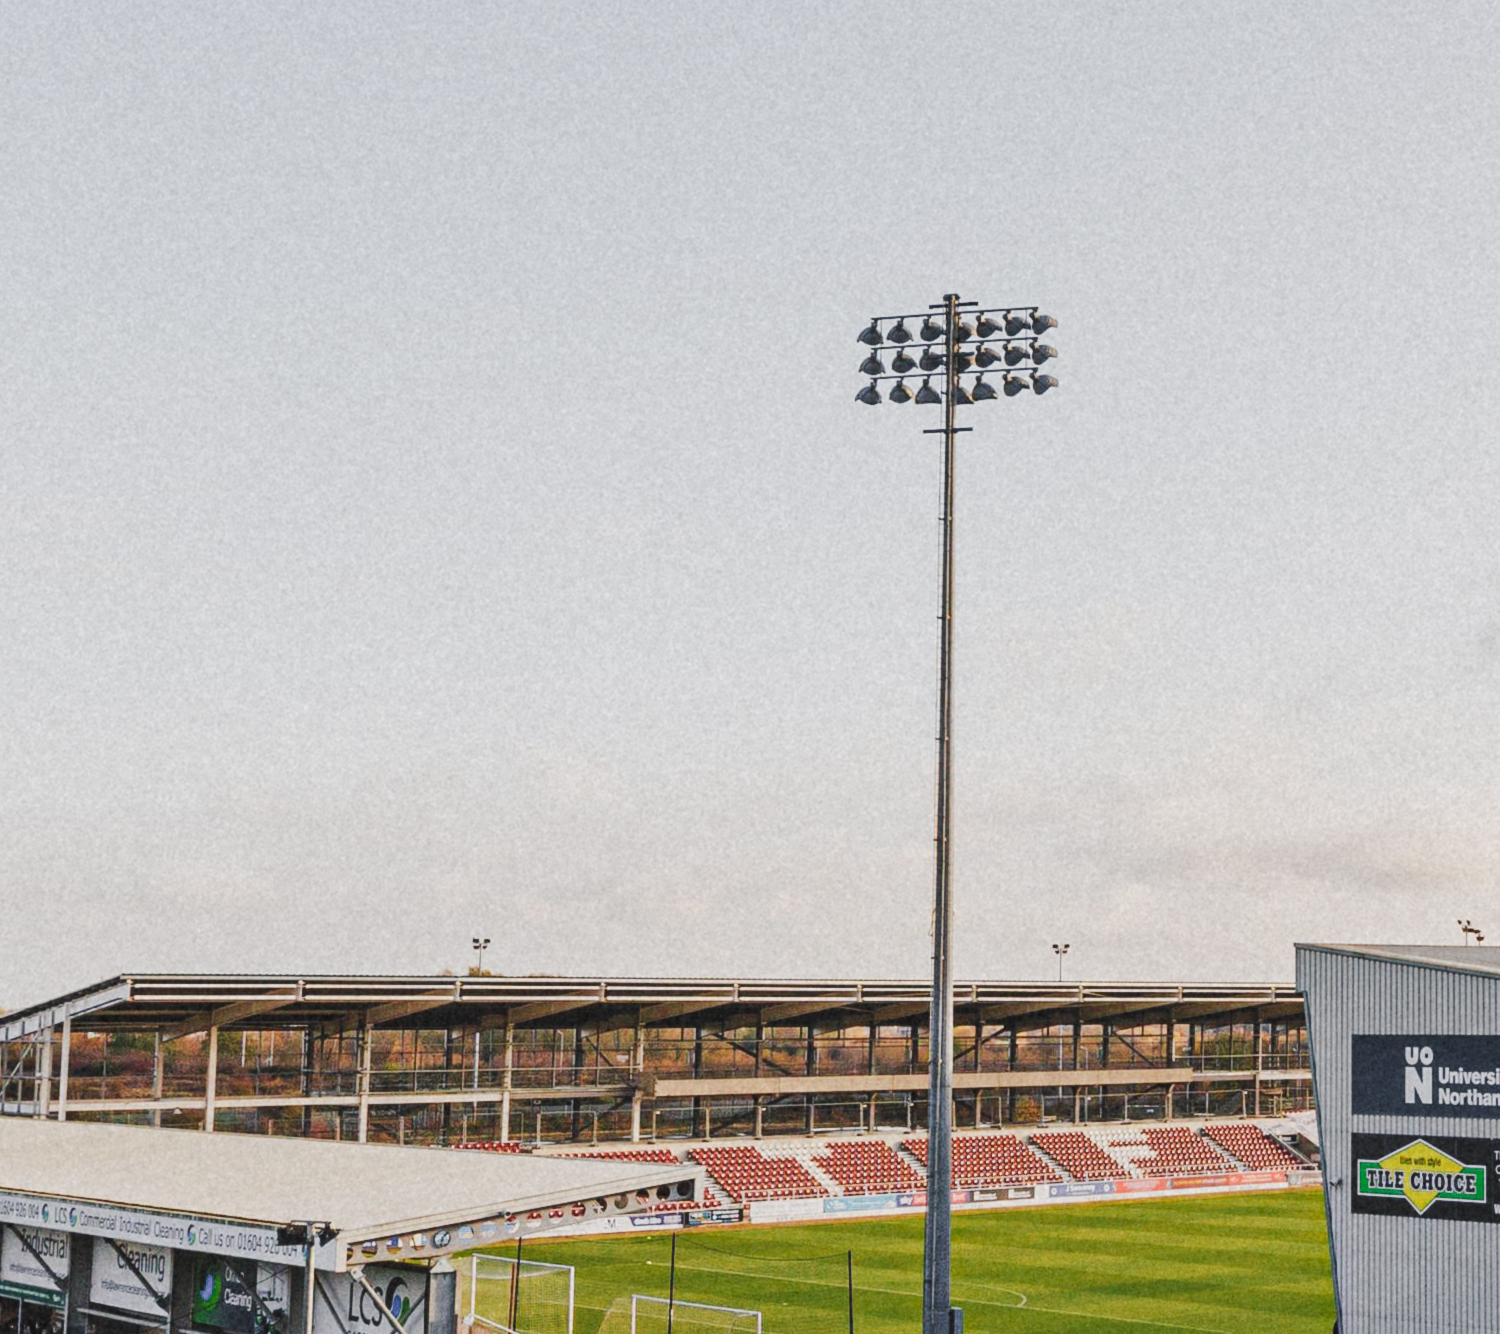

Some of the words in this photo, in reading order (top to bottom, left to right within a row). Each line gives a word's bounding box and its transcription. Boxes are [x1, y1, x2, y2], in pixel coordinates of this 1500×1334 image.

[1405, 1046, 1434, 1065] UO
[1405, 1067, 1433, 1104] N
[1367, 1169, 1404, 1188] TILE
[1410, 1171, 1476, 1193] CHOICE
[15, 1202, 27, 1218] 926
[28, 1204, 39, 1219] 004
[54, 1206, 67, 1225] LCS
[79, 1210, 116, 1231] Commercial
[119, 1216, 150, 1236] Industrial
[154, 1221, 184, 1244] Cleaning
[199, 1228, 214, 1246] Call
[216, 1233, 224, 1247] us
[225, 1234, 236, 1248] on
[237, 1233, 262, 1252] 01604
[224, 1288, 253, 1312] Cleaning
[348, 1282, 384, 1327] LCS
